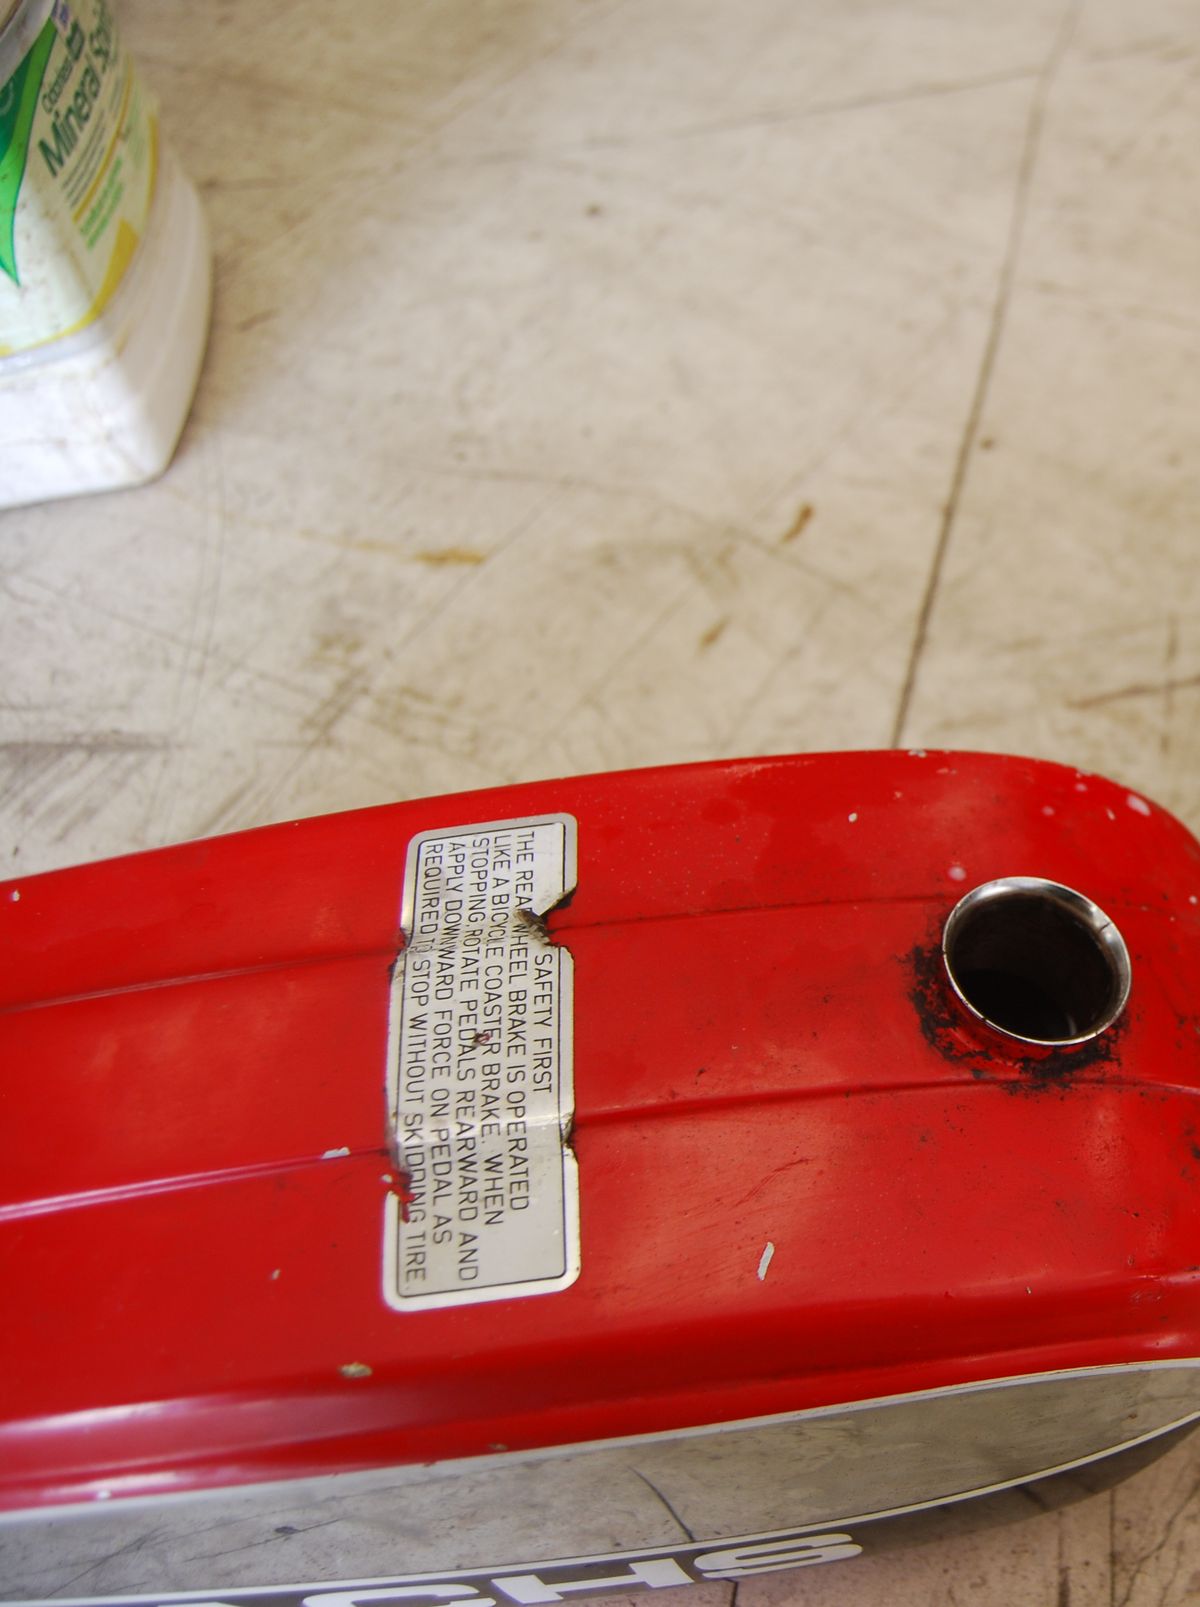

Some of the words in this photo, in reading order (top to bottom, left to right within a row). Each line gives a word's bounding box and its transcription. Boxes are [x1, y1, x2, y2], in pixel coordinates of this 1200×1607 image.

[445, 842, 466, 893] APPLY
[493, 834, 512, 872] LIKE
[516, 831, 535, 863] THE
[420, 843, 445, 935] REQUIRED
[491, 877, 510, 890] A
[434, 899, 464, 1001] DOWNWARD
[485, 893, 510, 960] BICYCLE
[508, 922, 529, 985] WHEEL
[409, 959, 431, 1008] STOP
[460, 928, 484, 993] ROTATE
[533, 953, 553, 1028] SAFETY
[457, 998, 478, 1083] PEDALS
[482, 964, 504, 1056] COASTER
[507, 989, 528, 1058] BRAKE
[404, 1013, 428, 1103] WITHOUT
[431, 1009, 453, 1080] FORCE
[506, 1064, 527, 1084] IS
[532, 1037, 553, 1094] FIRST
[430, 1088, 451, 1118] ON
[480, 1062, 501, 1145] BRAKE.
[430, 1128, 453, 1207] PEDAL
[455, 1089, 479, 1222] REARWARD
[507, 1090, 530, 1212] OPERATED
[483, 1153, 505, 1226] WHEN
[404, 1230, 427, 1283] TIRE
[432, 1214, 453, 1245] AS
[457, 1232, 479, 1281] AND
